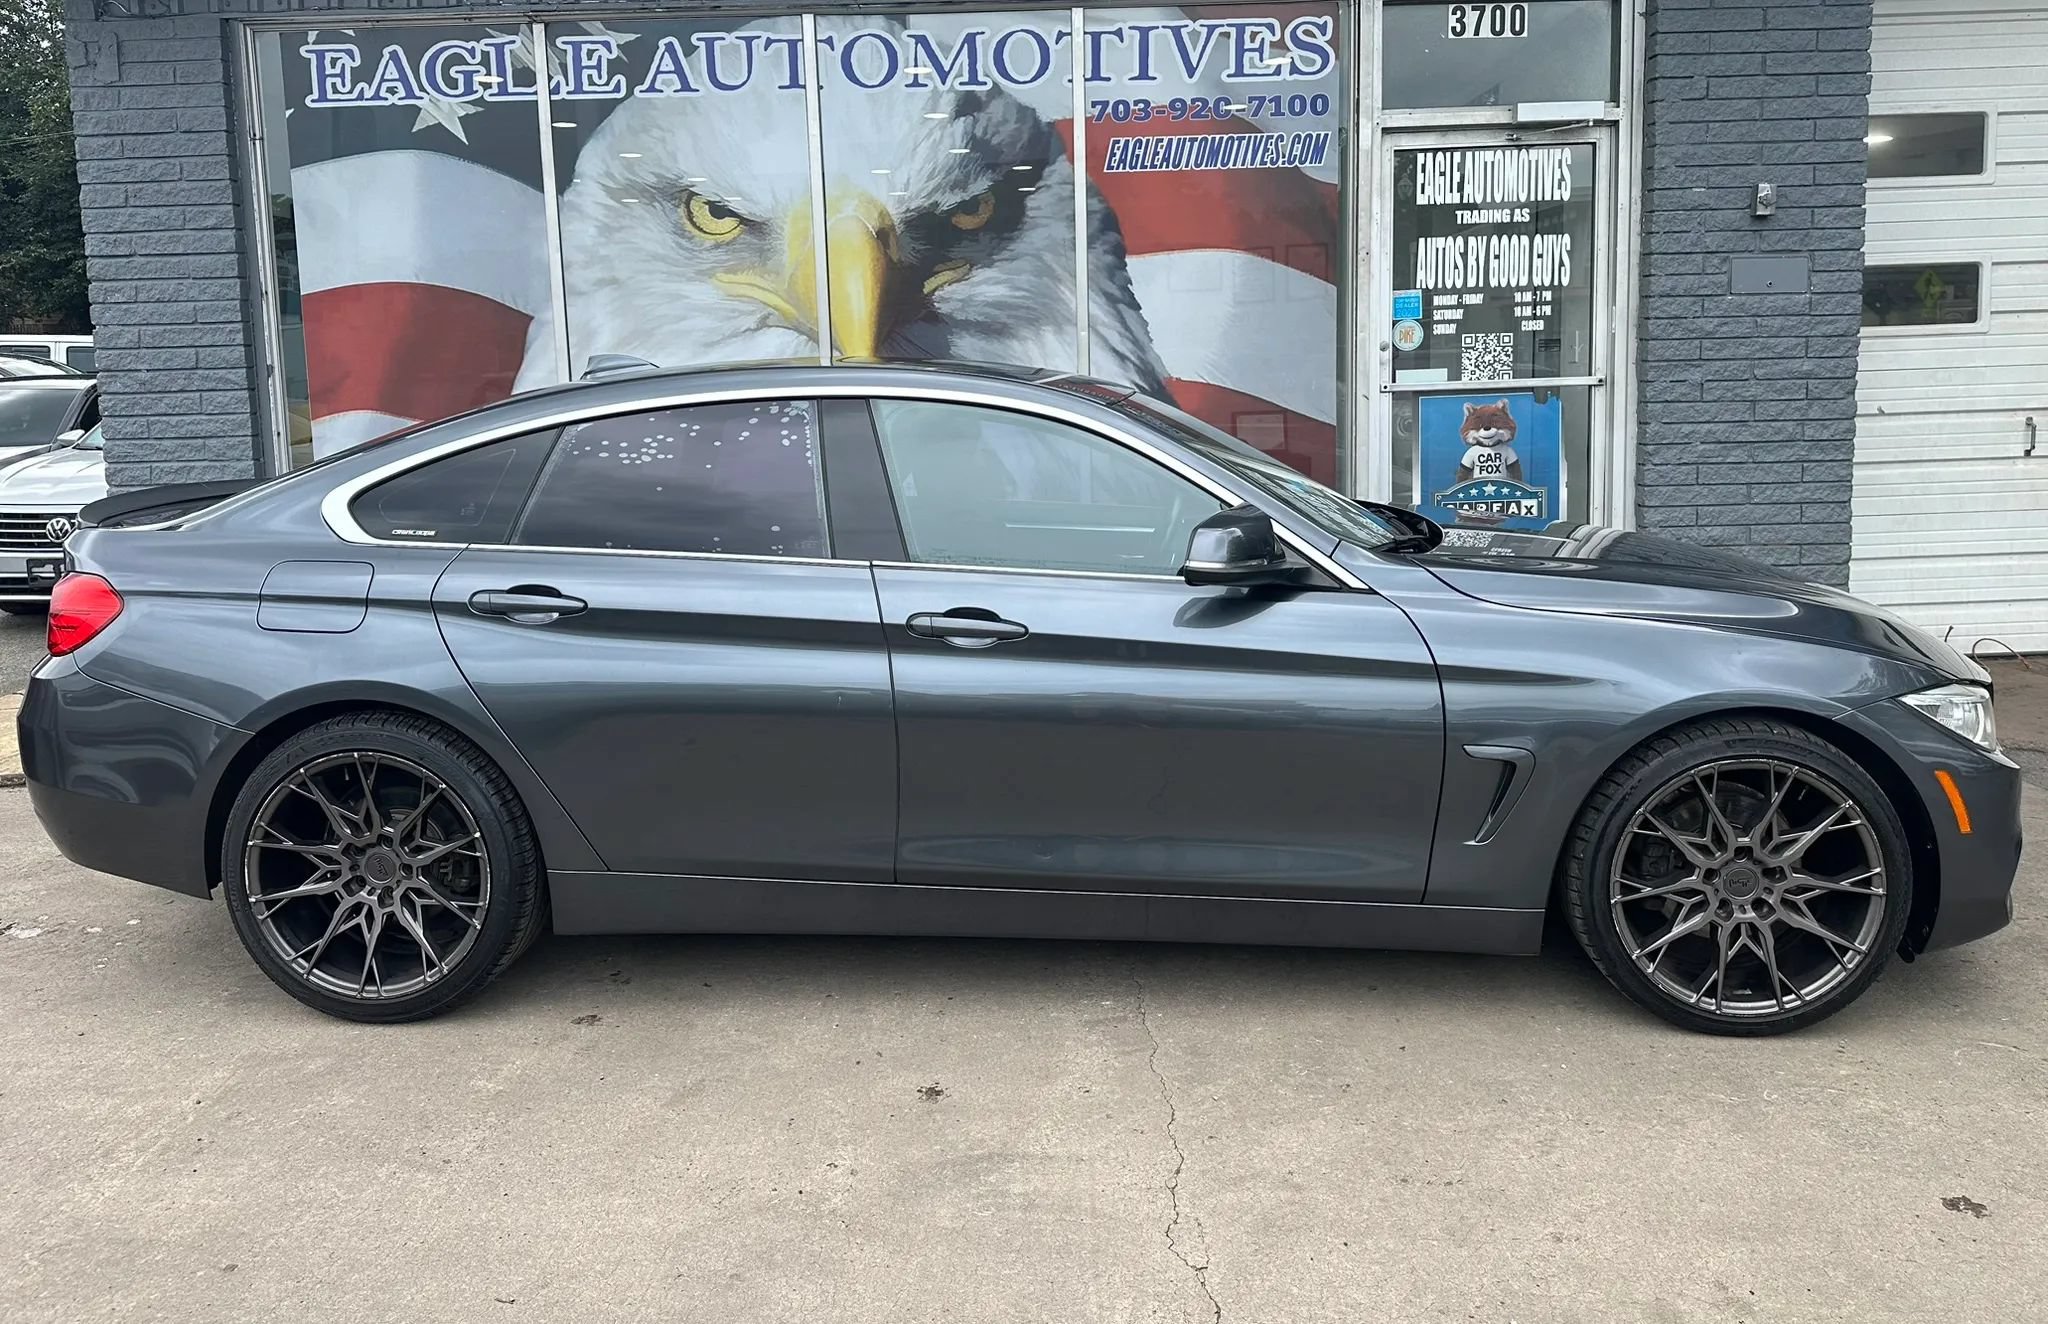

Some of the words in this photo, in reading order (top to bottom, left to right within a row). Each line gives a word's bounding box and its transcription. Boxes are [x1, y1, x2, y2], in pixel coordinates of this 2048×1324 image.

[1450, 4, 1526, 37] 3700
[303, 36, 624, 105] EAGLE
[635, 16, 1334, 97] AUTOMOTIVES
[1104, 131, 1331, 172] EAGLEAUTOMOTIVES.COM
[1416, 152, 1461, 205] EAGLE
[1463, 148, 1571, 204] AUTOMOTIVES
[1455, 209, 1510, 224] TRADING
[1513, 208, 1530, 222] AS
[1416, 236, 1464, 289] AUTOS
[1467, 235, 1487, 287] BY
[1489, 234, 1529, 288] GOOD
[1532, 233, 1571, 287] GUYS
[1433, 294, 1459, 306] MONDAY
[1463, 293, 1484, 305] FRIDAY
[1514, 291, 1521, 303] 10
[1522, 291, 1532, 302] AM
[1542, 290, 1552, 302] PM
[1433, 309, 1464, 320] SATURDAY
[1514, 306, 1521, 317] 10
[1522, 305, 1532, 316] AM
[1542, 305, 1552, 316] PM
[1433, 323, 1457, 335] SUNDAY
[1521, 320, 1544, 331] CLOSED
[1478, 453, 1502, 464] CAR
[1478, 464, 1502, 475] FOX
